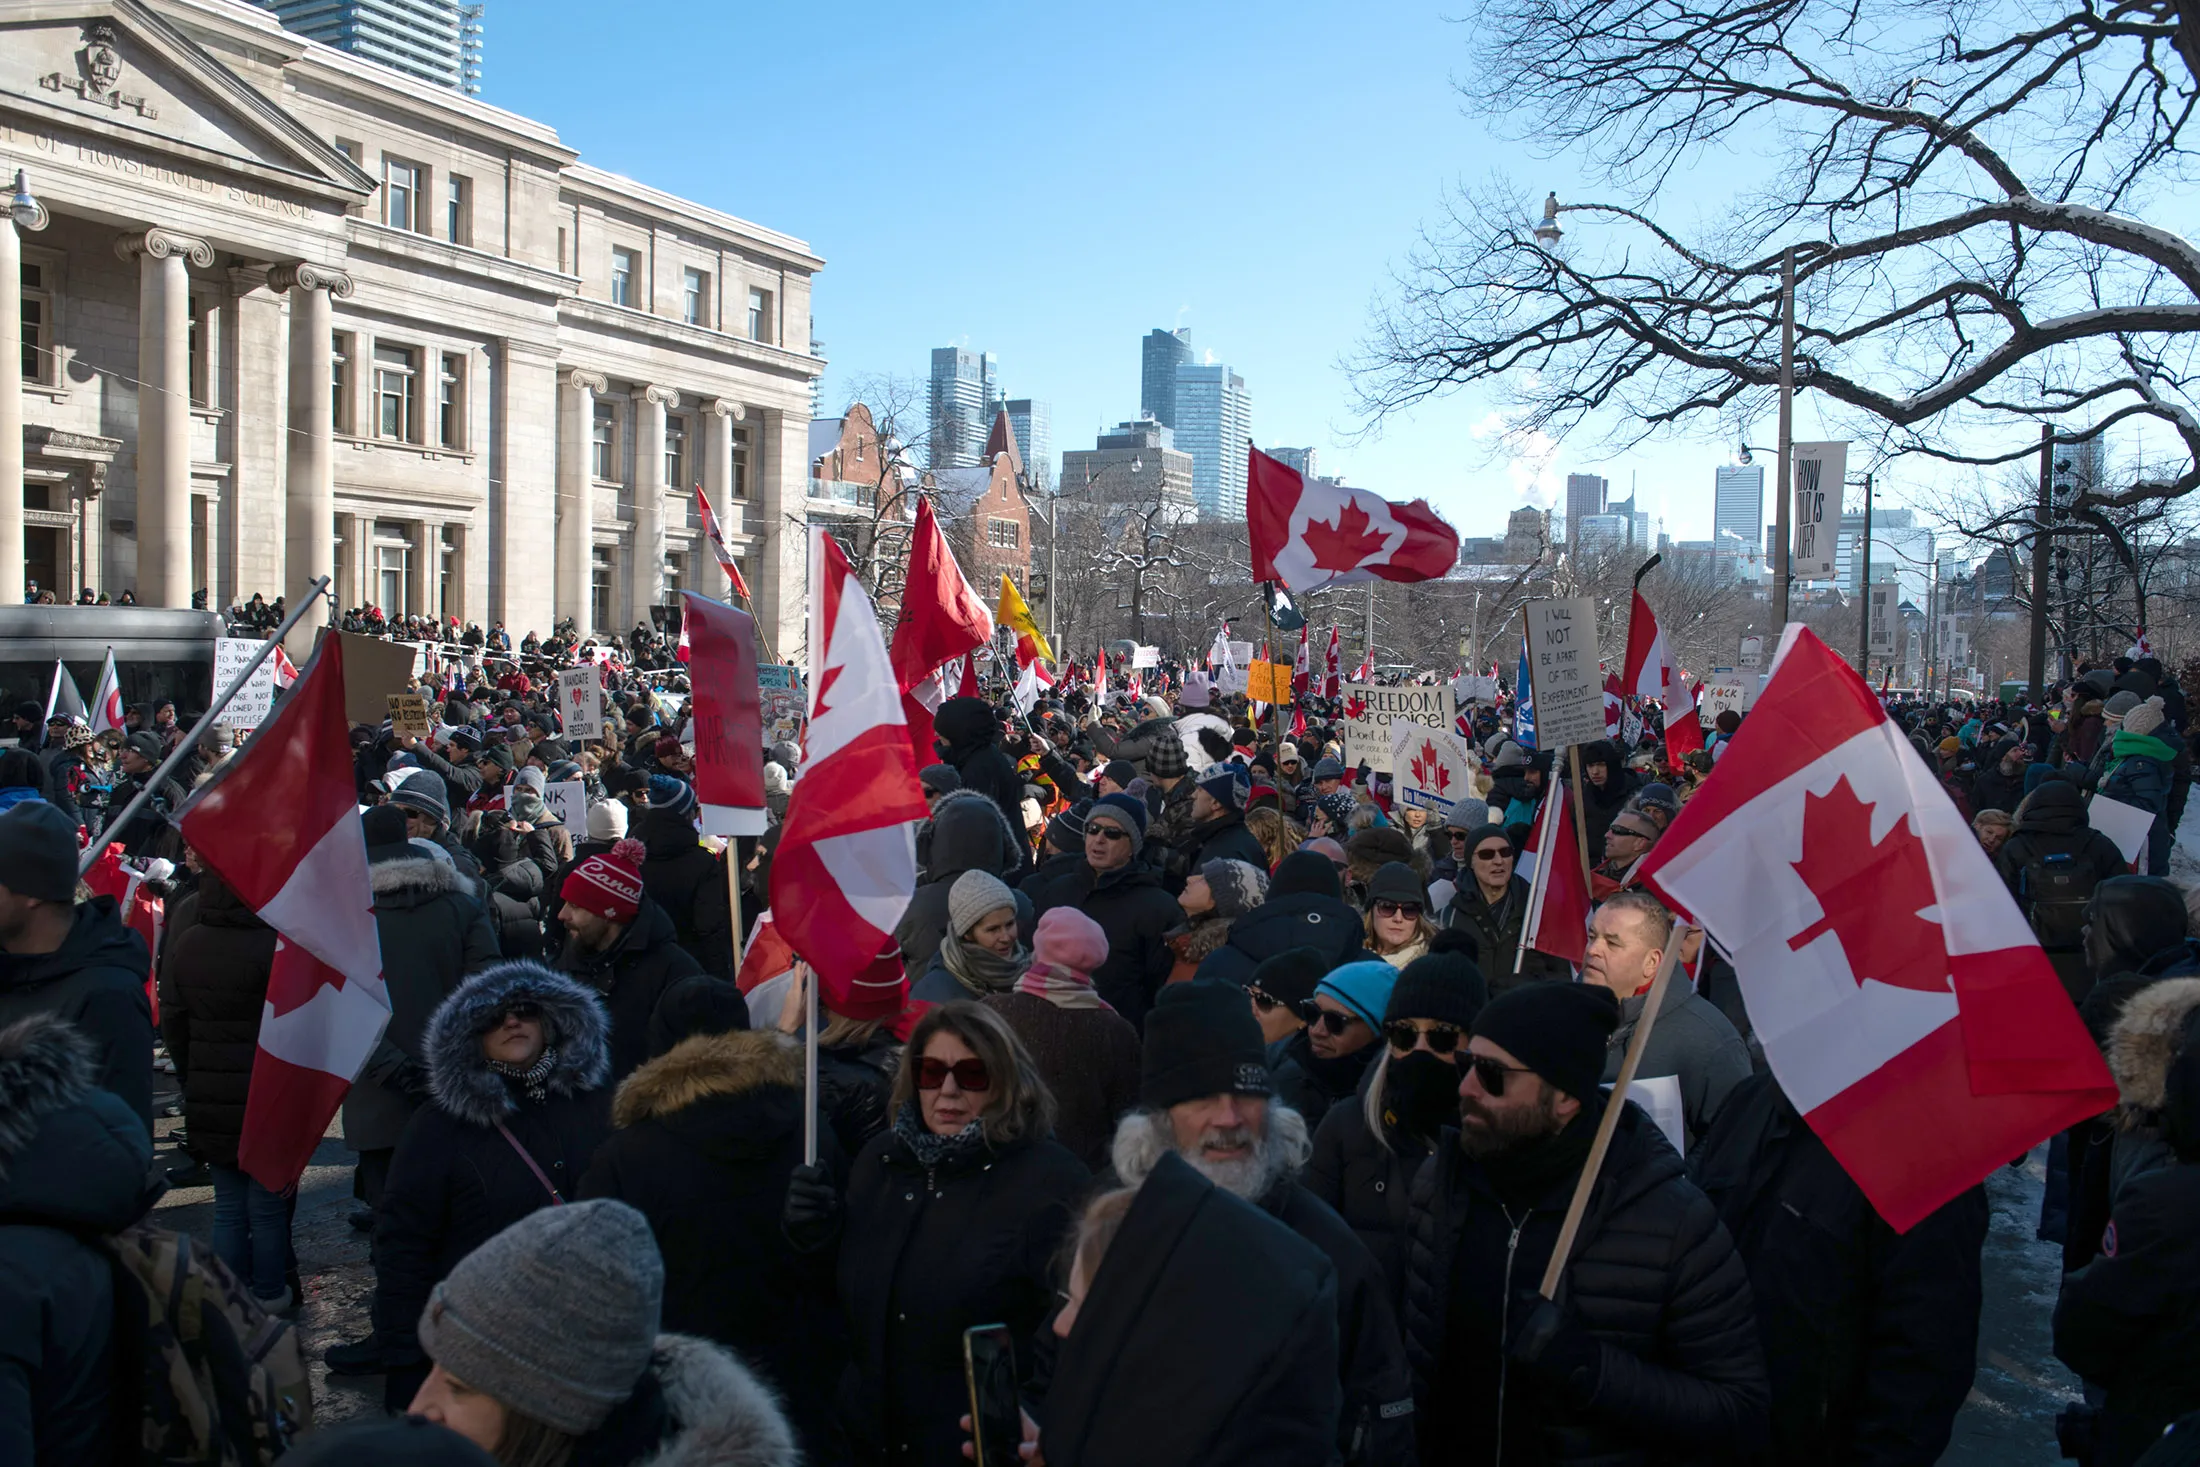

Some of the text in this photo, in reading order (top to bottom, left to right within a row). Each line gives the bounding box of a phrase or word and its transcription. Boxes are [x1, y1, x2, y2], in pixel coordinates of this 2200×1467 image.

[228, 181, 316, 221] SCIENCE
[1798, 459, 1822, 491] HOW
[1812, 492, 1825, 523] IS
[1798, 524, 1815, 559] LIFE?
[1545, 608, 1572, 623] I WILL
[1546, 627, 1571, 646] NOT
[218, 641, 229, 652] IF
[234, 642, 250, 652] YOU
[217, 655, 252, 664] TO KNO
[1541, 650, 1578, 666] BE APART
[259, 668, 271, 677] YOU
[564, 672, 589, 687] MANDATE
[1548, 668, 1578, 683] OF THIS
[216, 680, 233, 688] LOO
[251, 680, 267, 688] WHO
[255, 691, 271, 700] NOT
[570, 689, 589, 704] LVE
[1541, 685, 1589, 705] EXPERIMENT
[1710, 687, 1737, 698] FCK
[222, 703, 267, 713] LLOWED TO
[1354, 690, 1442, 712] FREEDOM
[1714, 700, 1731, 711] YOU
[573, 709, 585, 721] AND
[1356, 711, 1375, 723] OF
[1700, 714, 1717, 725] TRU
[569, 722, 594, 737] FREEDOM
[579, 861, 642, 900] Canad
